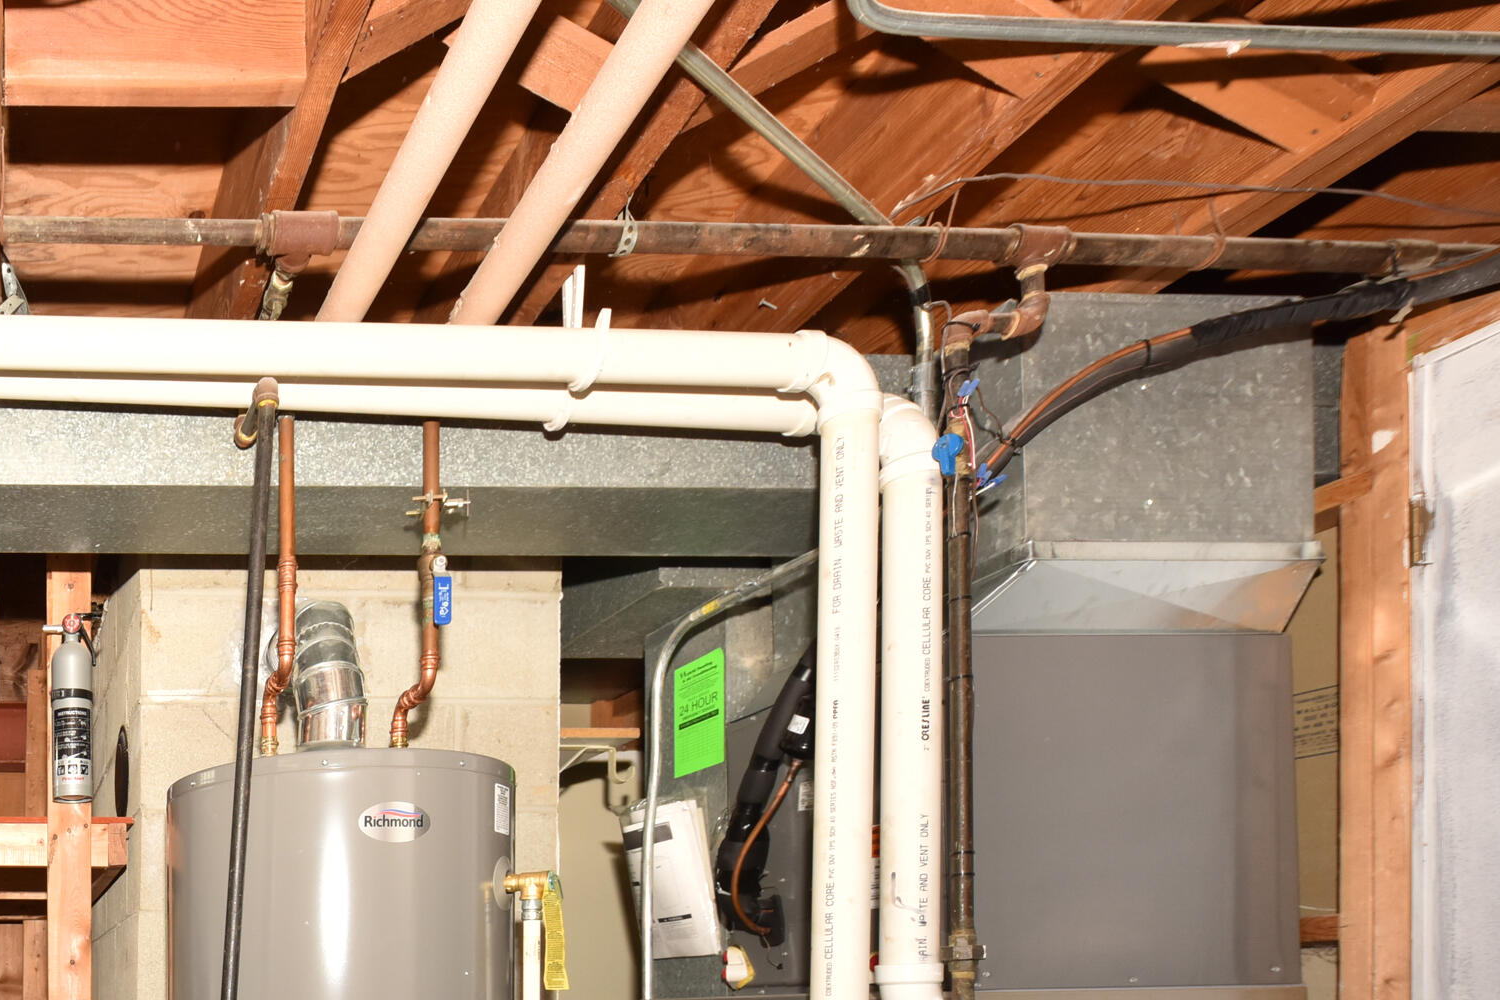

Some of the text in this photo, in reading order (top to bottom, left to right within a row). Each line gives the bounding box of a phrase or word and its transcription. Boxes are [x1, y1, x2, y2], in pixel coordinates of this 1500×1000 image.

[835, 436, 845, 460] ONLY
[835, 466, 844, 490] VENT
[834, 494, 844, 513] AND
[921, 577, 931, 601] CORE
[921, 607, 931, 656] CELLULAR
[691, 690, 719, 711] HOUR
[363, 813, 424, 828] Richmond
[919, 813, 929, 838] ONLY
[919, 844, 929, 868] VENT
[919, 872, 929, 892] AND
[824, 882, 835, 907] CORE
[824, 912, 834, 960] CELLULAR
